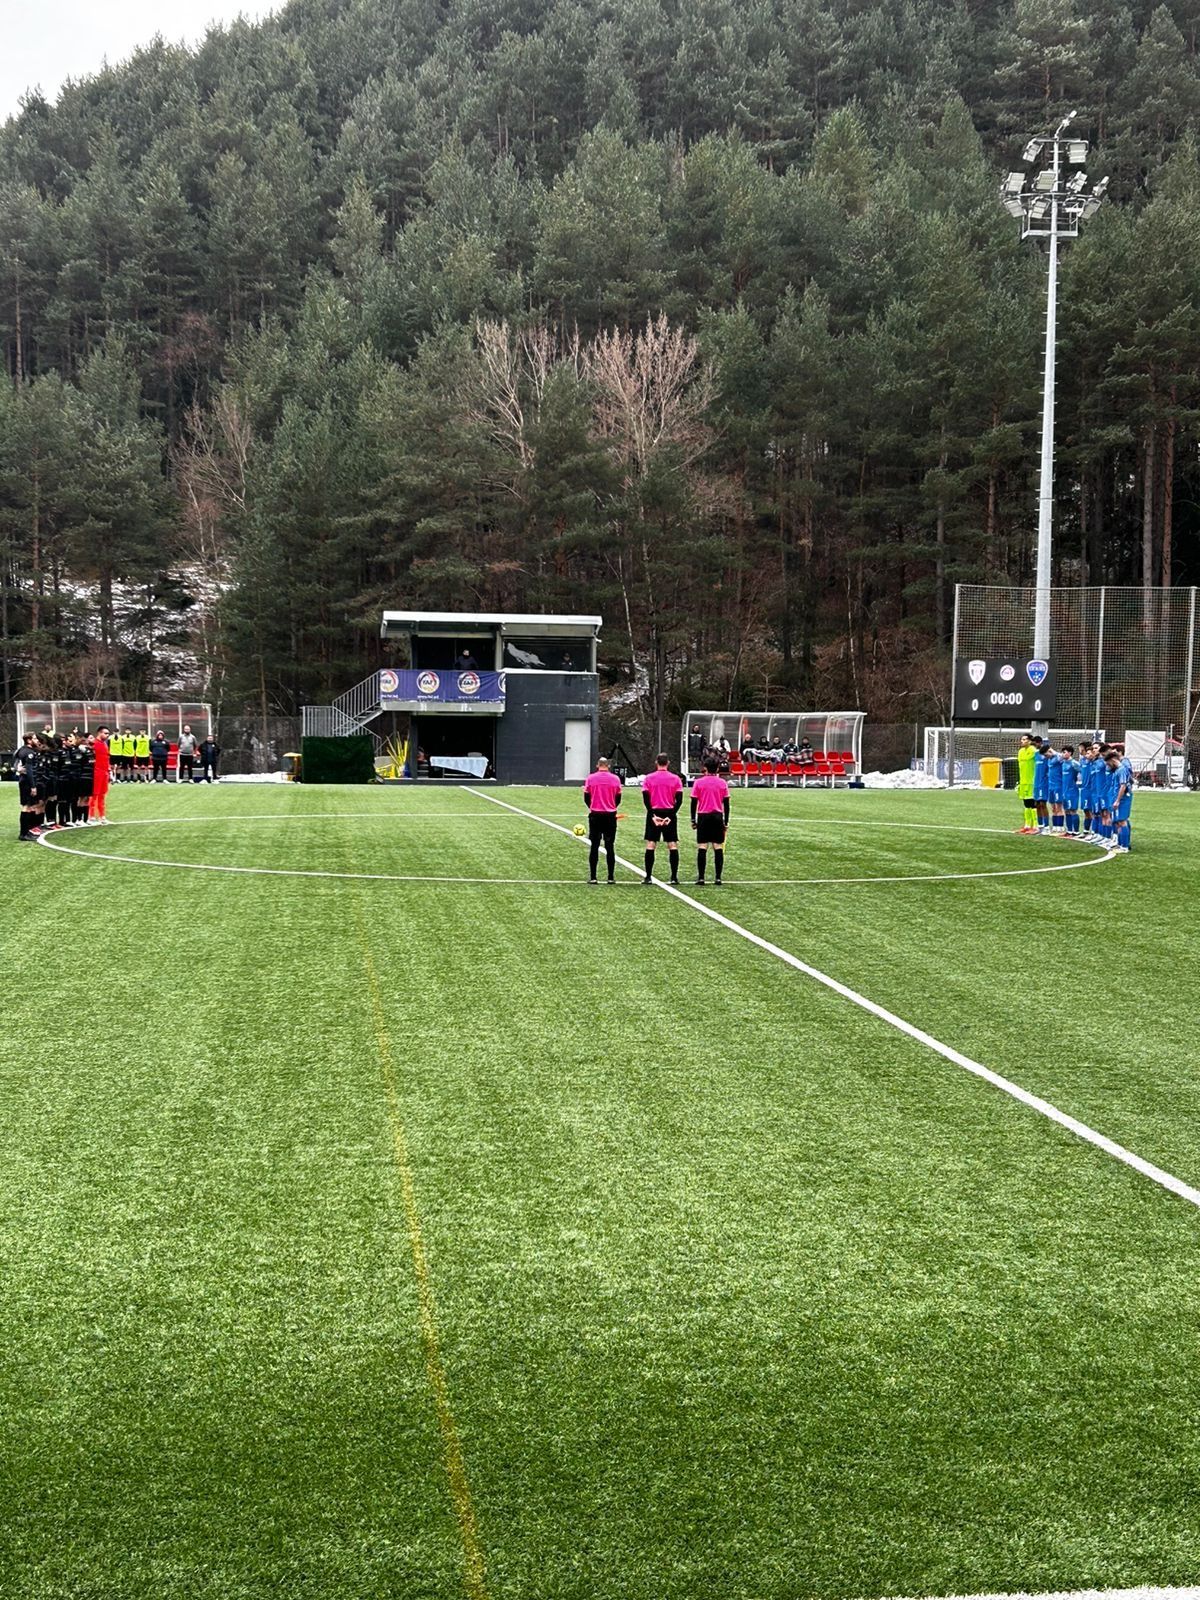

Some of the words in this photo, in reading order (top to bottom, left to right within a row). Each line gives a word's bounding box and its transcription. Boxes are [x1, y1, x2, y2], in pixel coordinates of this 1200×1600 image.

[971, 699, 979, 711] 0
[990, 692, 1023, 705] 00:00
[1034, 699, 1042, 712] 0
